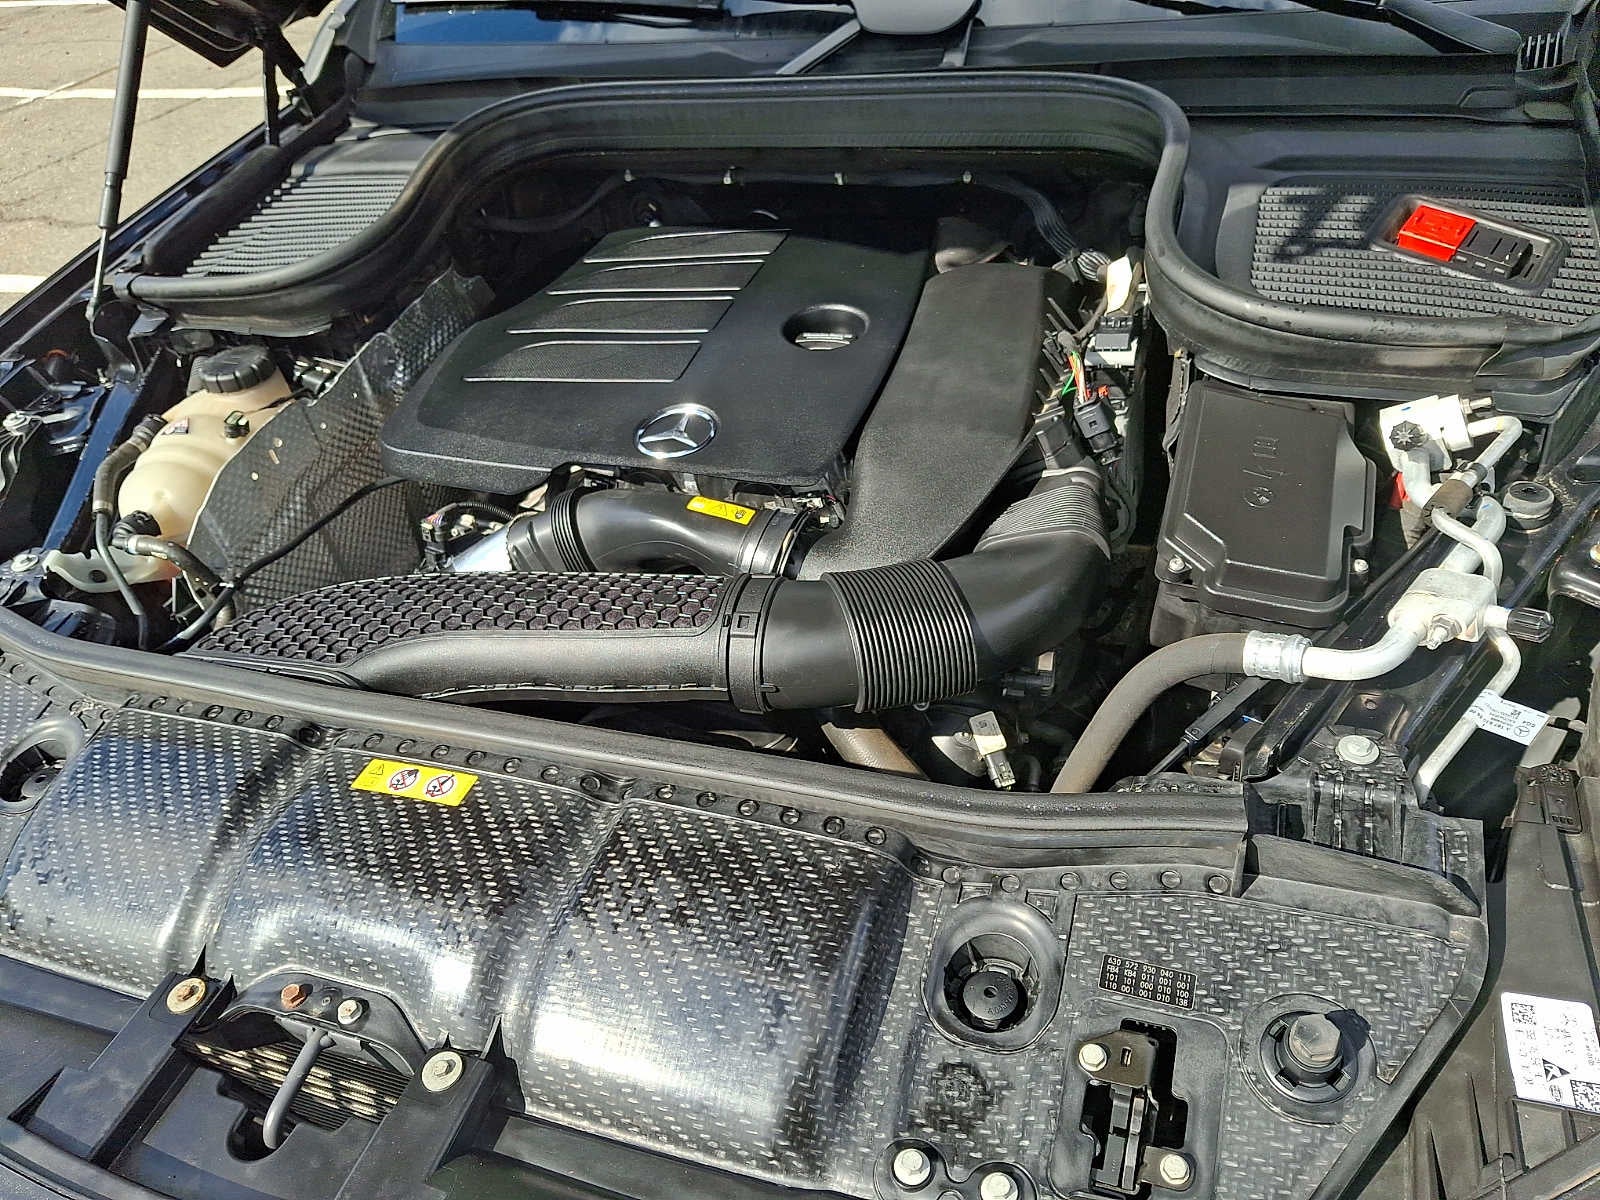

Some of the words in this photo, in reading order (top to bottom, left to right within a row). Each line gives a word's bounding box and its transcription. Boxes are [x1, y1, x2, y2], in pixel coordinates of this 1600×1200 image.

[1107, 957, 1121, 966] 630
[1126, 961, 1138, 970] 572
[1142, 965, 1156, 974] 930
[1160, 969, 1174, 978] 040
[1179, 974, 1191, 982] 111
[1105, 981, 1117, 990] 110
[1121, 985, 1134, 994] 001
[1139, 990, 1152, 998] 001
[1156, 994, 1170, 1002] 010
[1106, 973, 1118, 981] 101
[1124, 977, 1135, 986] 101
[1140, 981, 1153, 990] 000
[1158, 985, 1171, 994] 010
[1177, 990, 1189, 998] 100
[1142, 974, 1154, 982] 011
[1159, 977, 1172, 986] 001
[1177, 981, 1190, 990] 001
